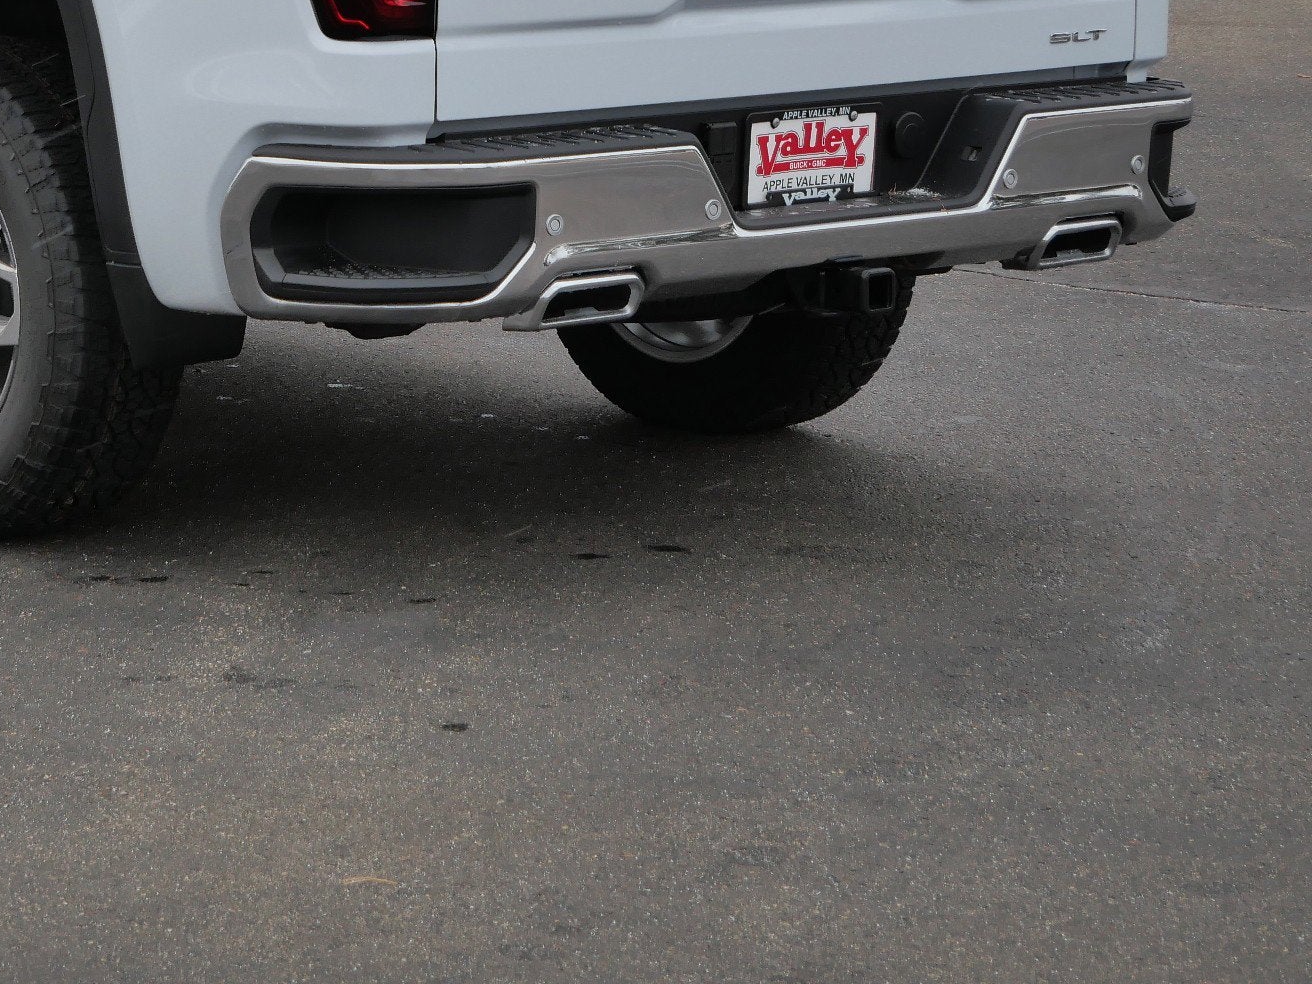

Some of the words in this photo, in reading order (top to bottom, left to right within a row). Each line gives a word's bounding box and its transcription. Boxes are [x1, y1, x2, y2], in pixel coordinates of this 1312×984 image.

[1049, 29, 1107, 44] SLT
[783, 110, 807, 120] APPLE
[808, 108, 838, 117] VALLEY,
[839, 106, 851, 115] MN
[756, 120, 869, 178] Valley
[789, 162, 808, 170] BUICK
[812, 159, 827, 167] GMC
[762, 178, 793, 192] APPLE
[796, 174, 836, 187] VALLEY,
[839, 173, 855, 184] MN
[782, 187, 841, 206] Valley
